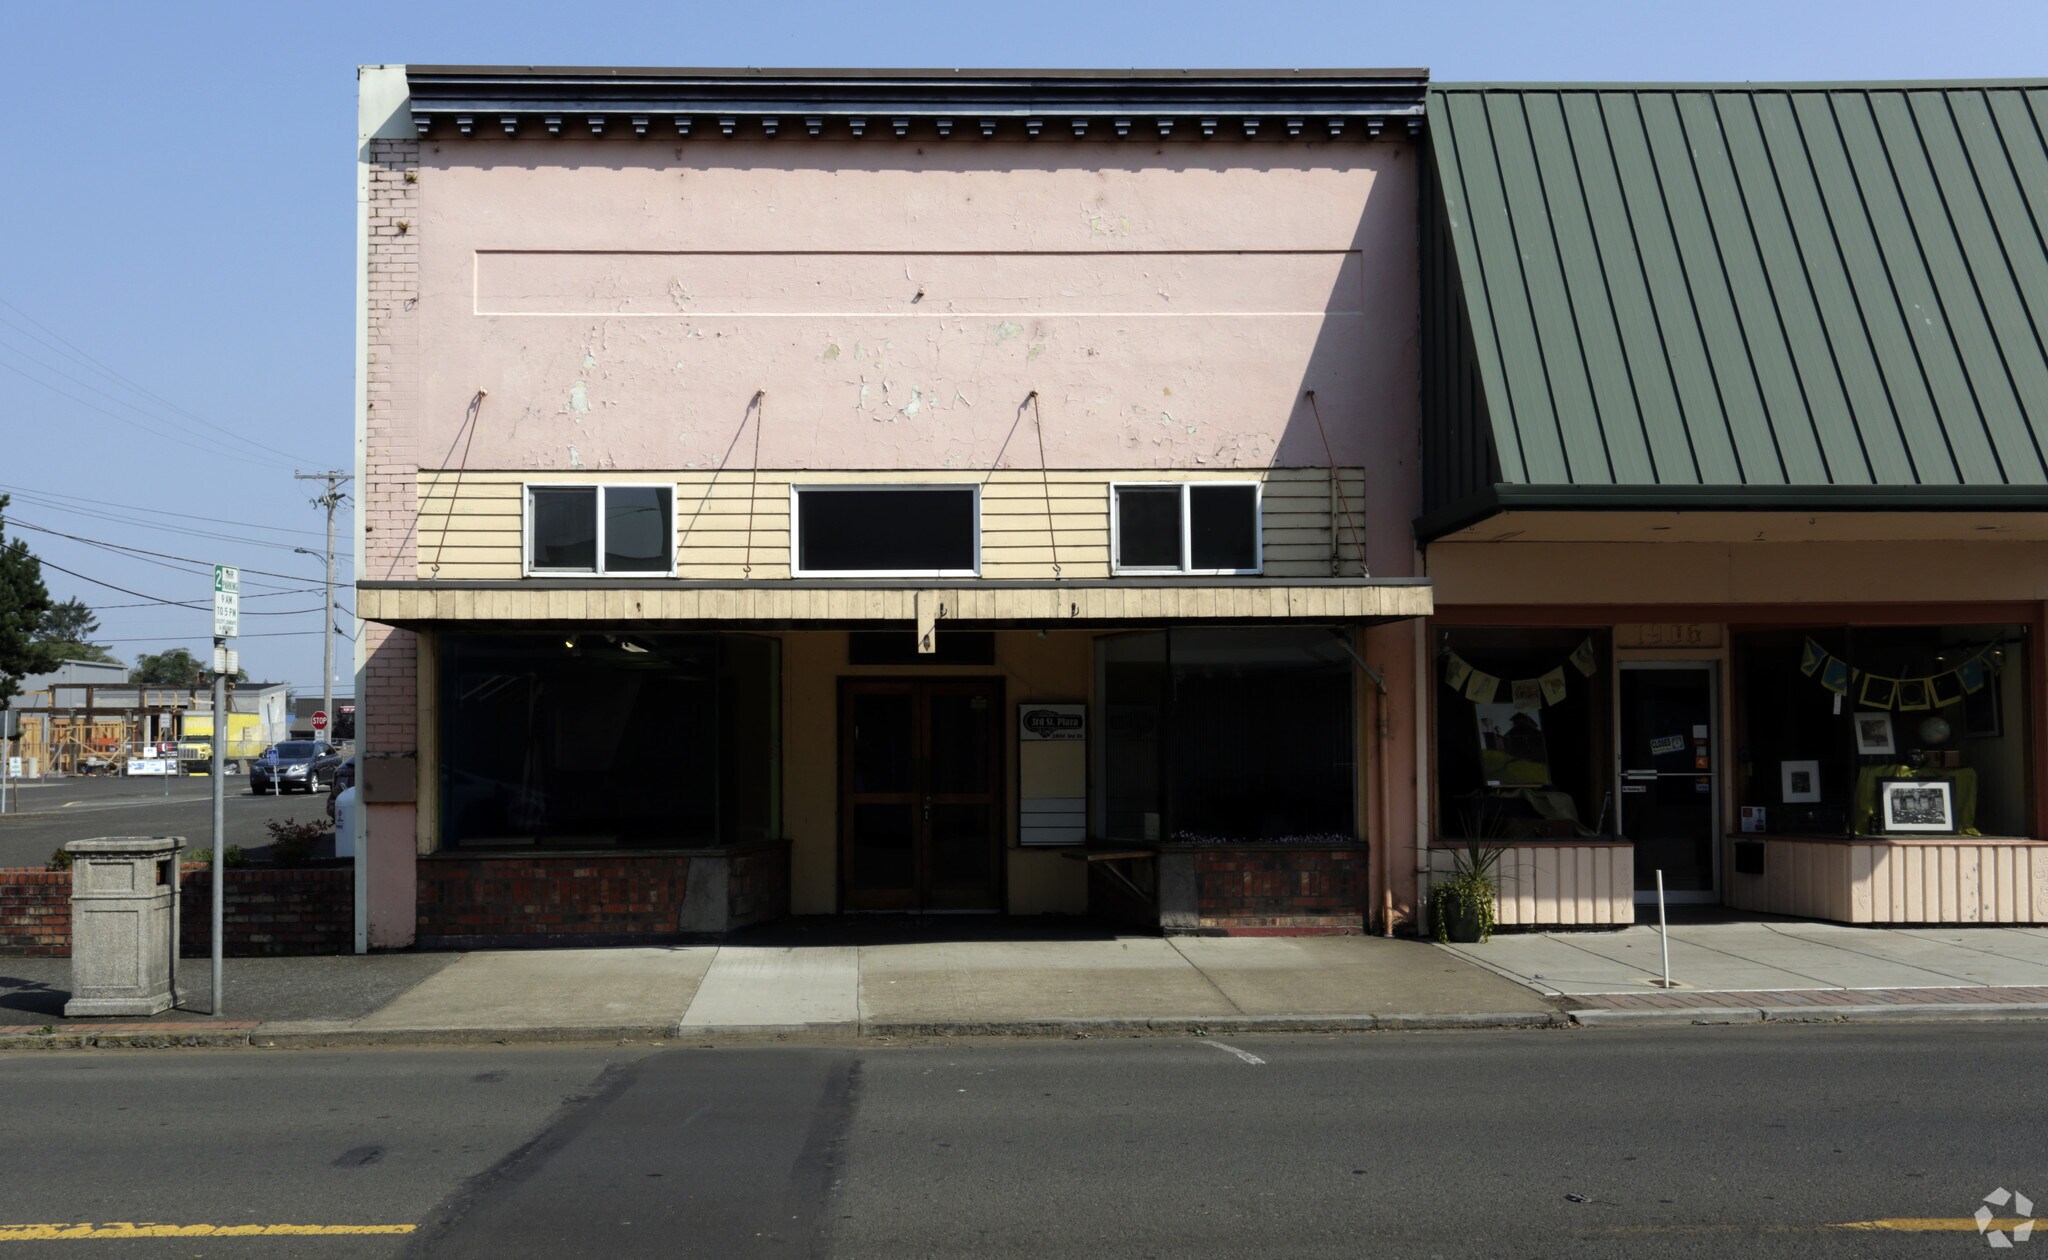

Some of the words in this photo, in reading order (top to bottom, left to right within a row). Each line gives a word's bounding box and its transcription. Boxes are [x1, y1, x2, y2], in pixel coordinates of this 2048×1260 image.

[216, 570, 222, 588] 2
[222, 581, 238, 591] PARKING
[221, 594, 225, 603] 9
[226, 595, 233, 604] AM
[217, 606, 223, 616] TO
[225, 607, 228, 616] 5
[229, 608, 236, 617] PM
[313, 717, 327, 725] STOP
[1031, 717, 1044, 727] 3rd
[1046, 717, 1055, 727] St.
[1057, 717, 1079, 727] Plaza
[1651, 737, 1672, 749] CLOSED
